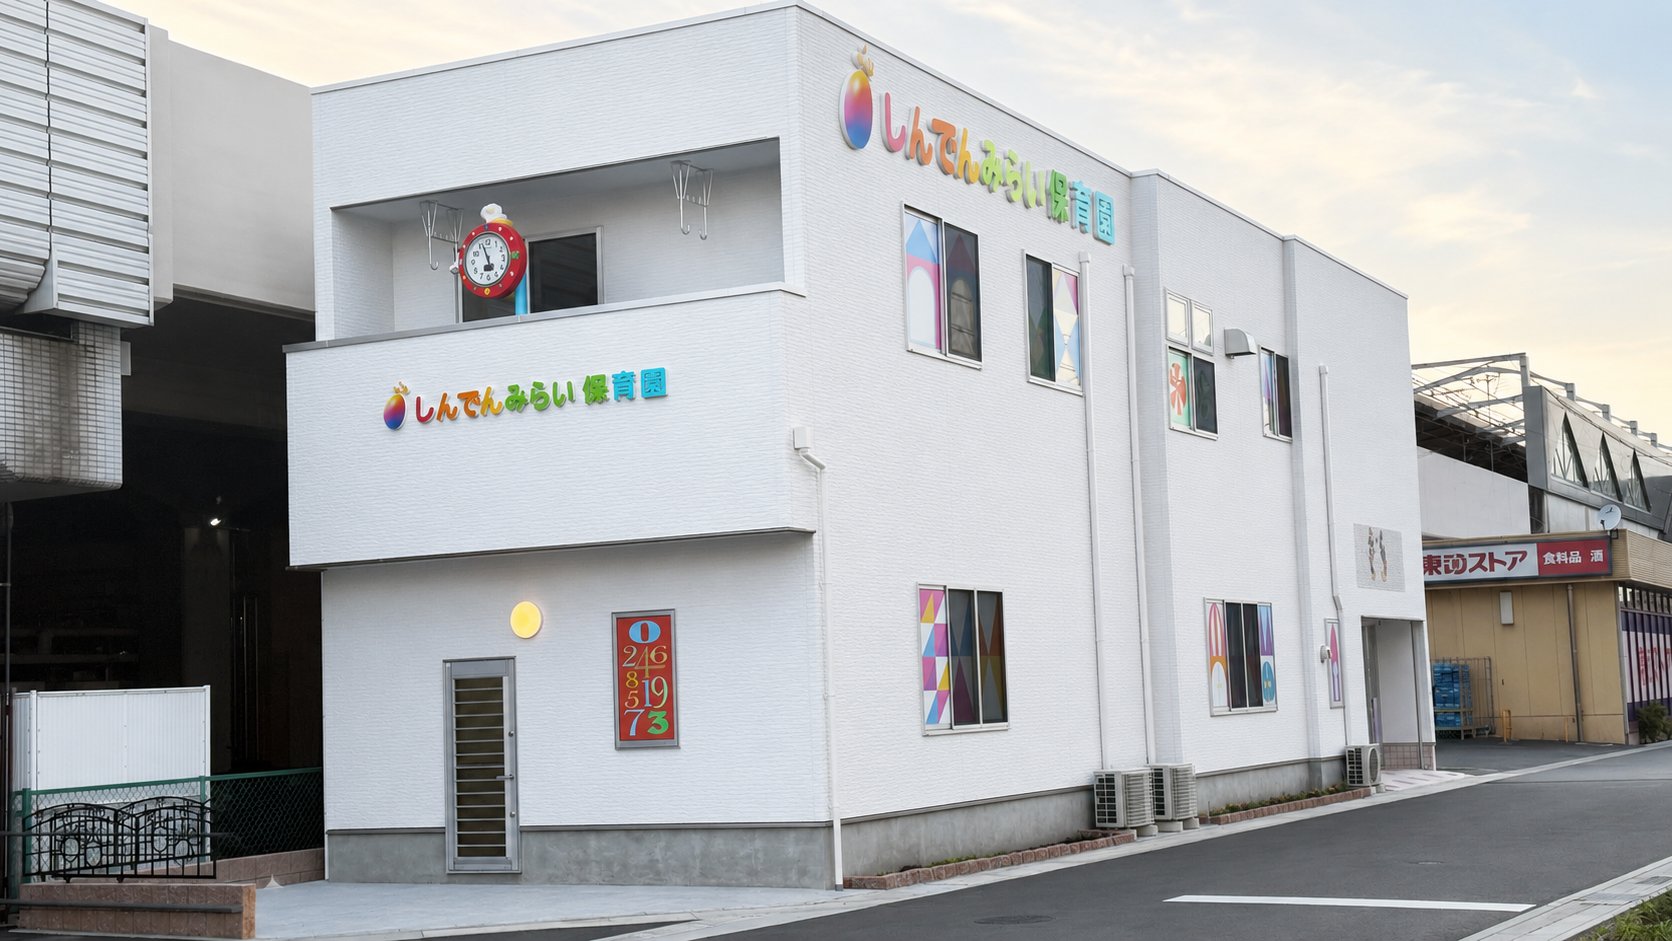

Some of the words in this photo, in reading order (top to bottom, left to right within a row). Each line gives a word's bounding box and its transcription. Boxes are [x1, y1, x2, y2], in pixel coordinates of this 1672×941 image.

[880, 91, 1116, 245] しんでんみらい保育園
[415, 367, 668, 424] しんでんみらい保育園
[1542, 550, 1582, 565] 食料品
